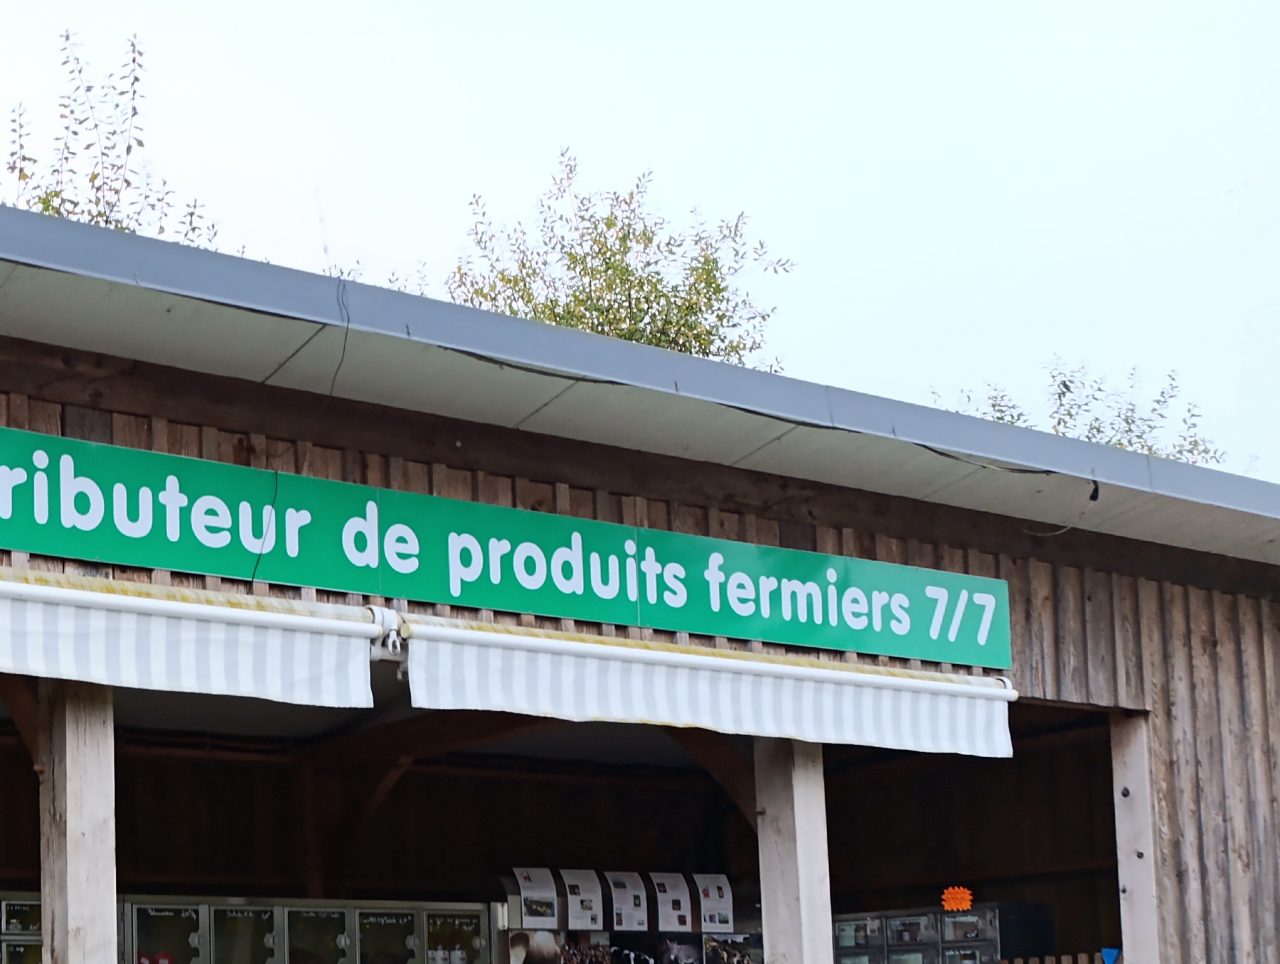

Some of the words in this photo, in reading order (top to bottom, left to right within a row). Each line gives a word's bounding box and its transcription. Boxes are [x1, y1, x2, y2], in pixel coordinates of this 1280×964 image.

[342, 501, 420, 574] de
[448, 532, 688, 608] produits
[704, 552, 911, 635] fermiers
[925, 585, 996, 646] 7/7
